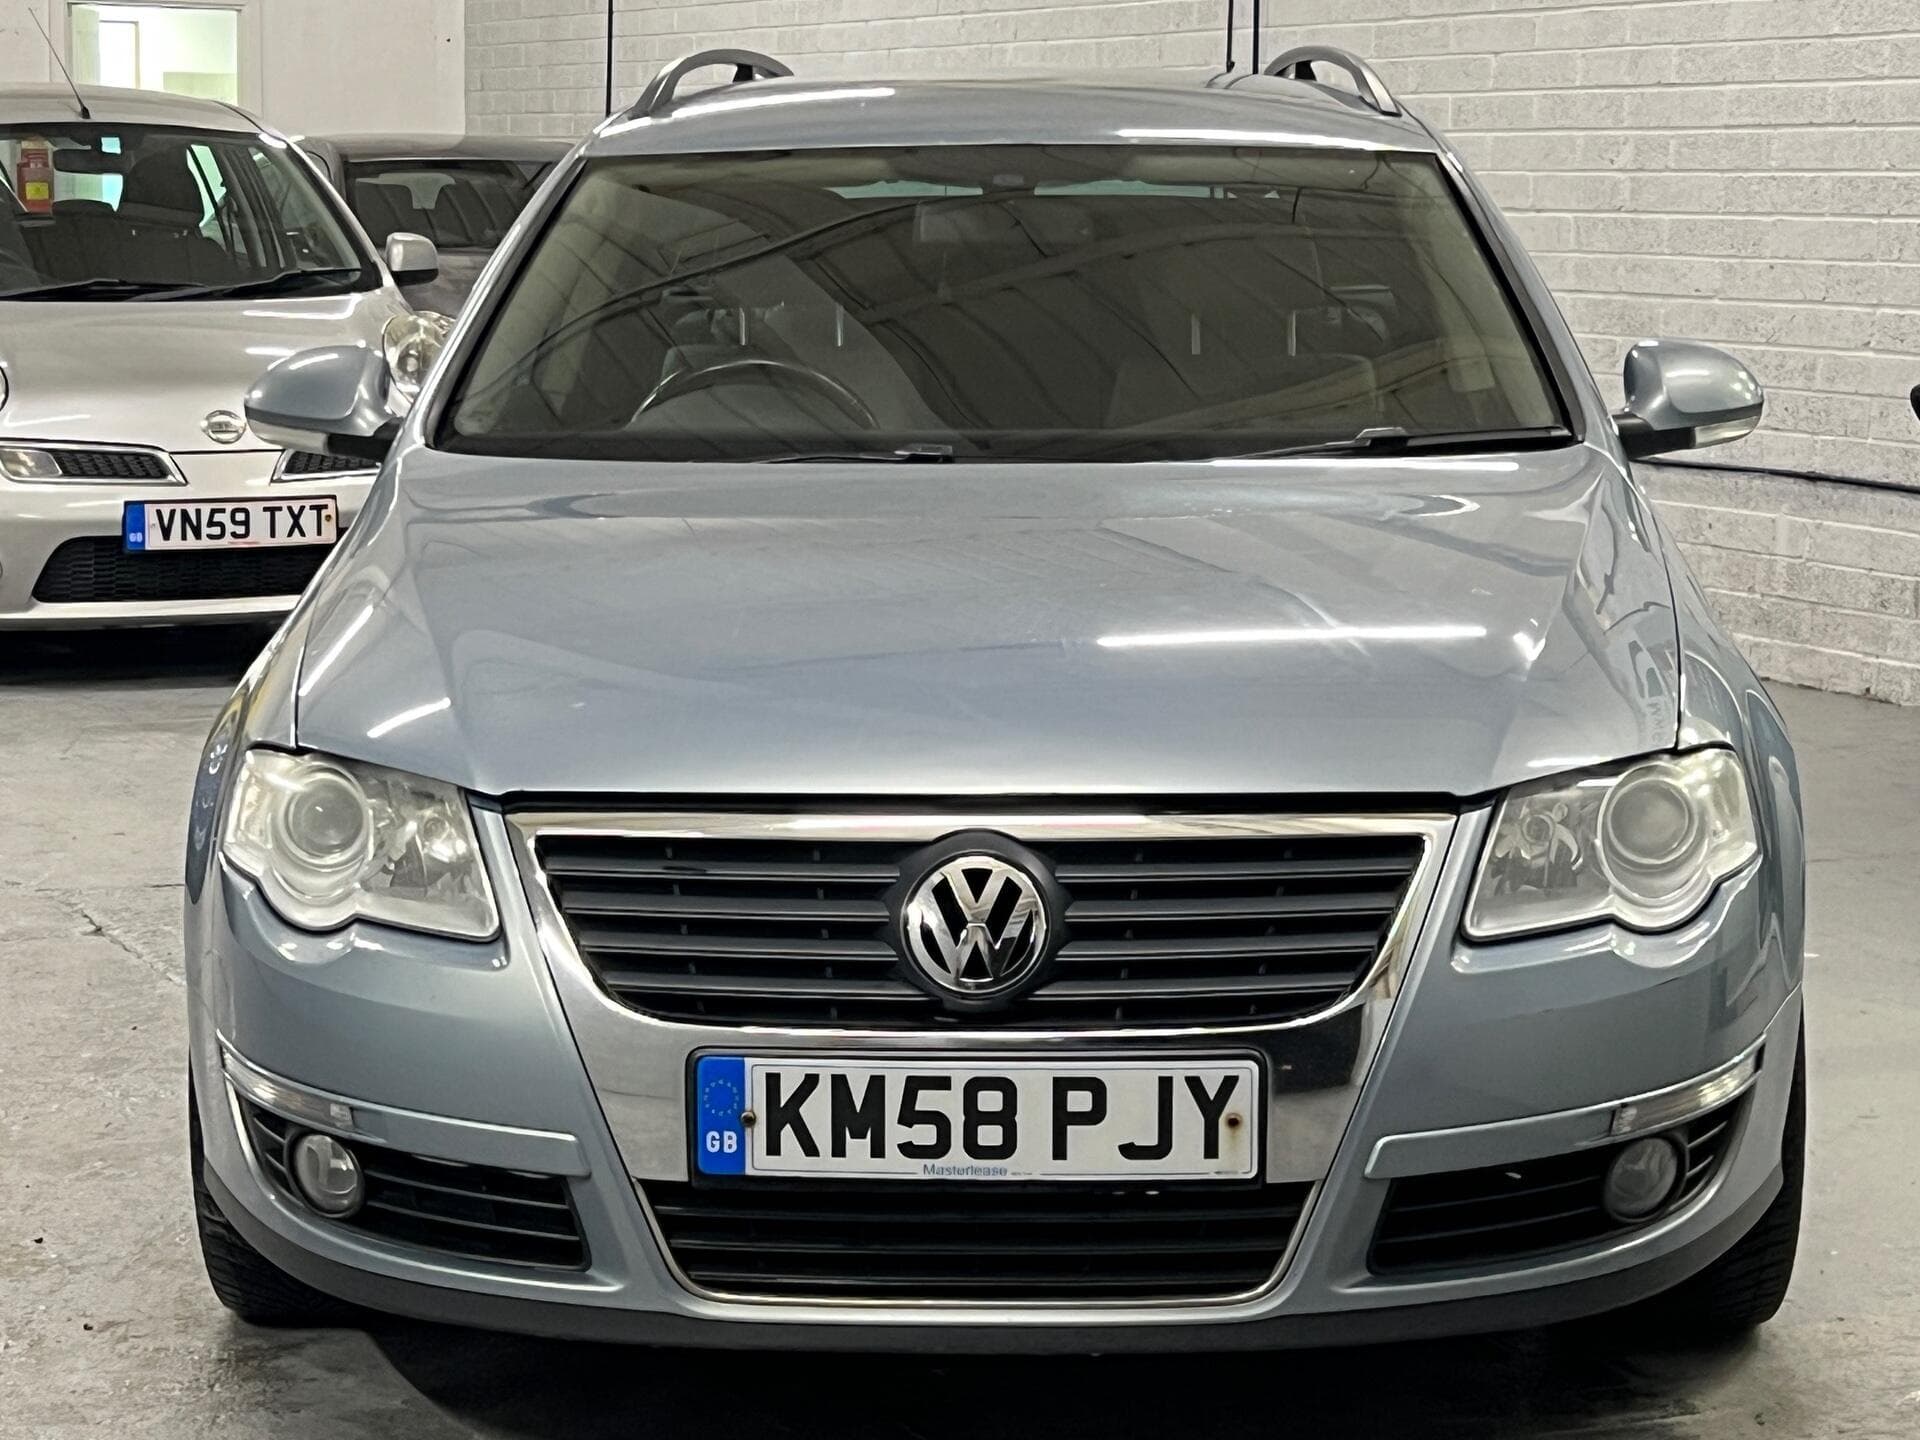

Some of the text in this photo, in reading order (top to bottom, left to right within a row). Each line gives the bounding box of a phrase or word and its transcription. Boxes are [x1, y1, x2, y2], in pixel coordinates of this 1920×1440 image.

[155, 503, 329, 541] VN59 TXT
[764, 1072, 1018, 1161] KM58
[705, 1130, 738, 1154] GB
[923, 1163, 1008, 1177] Masterlease
